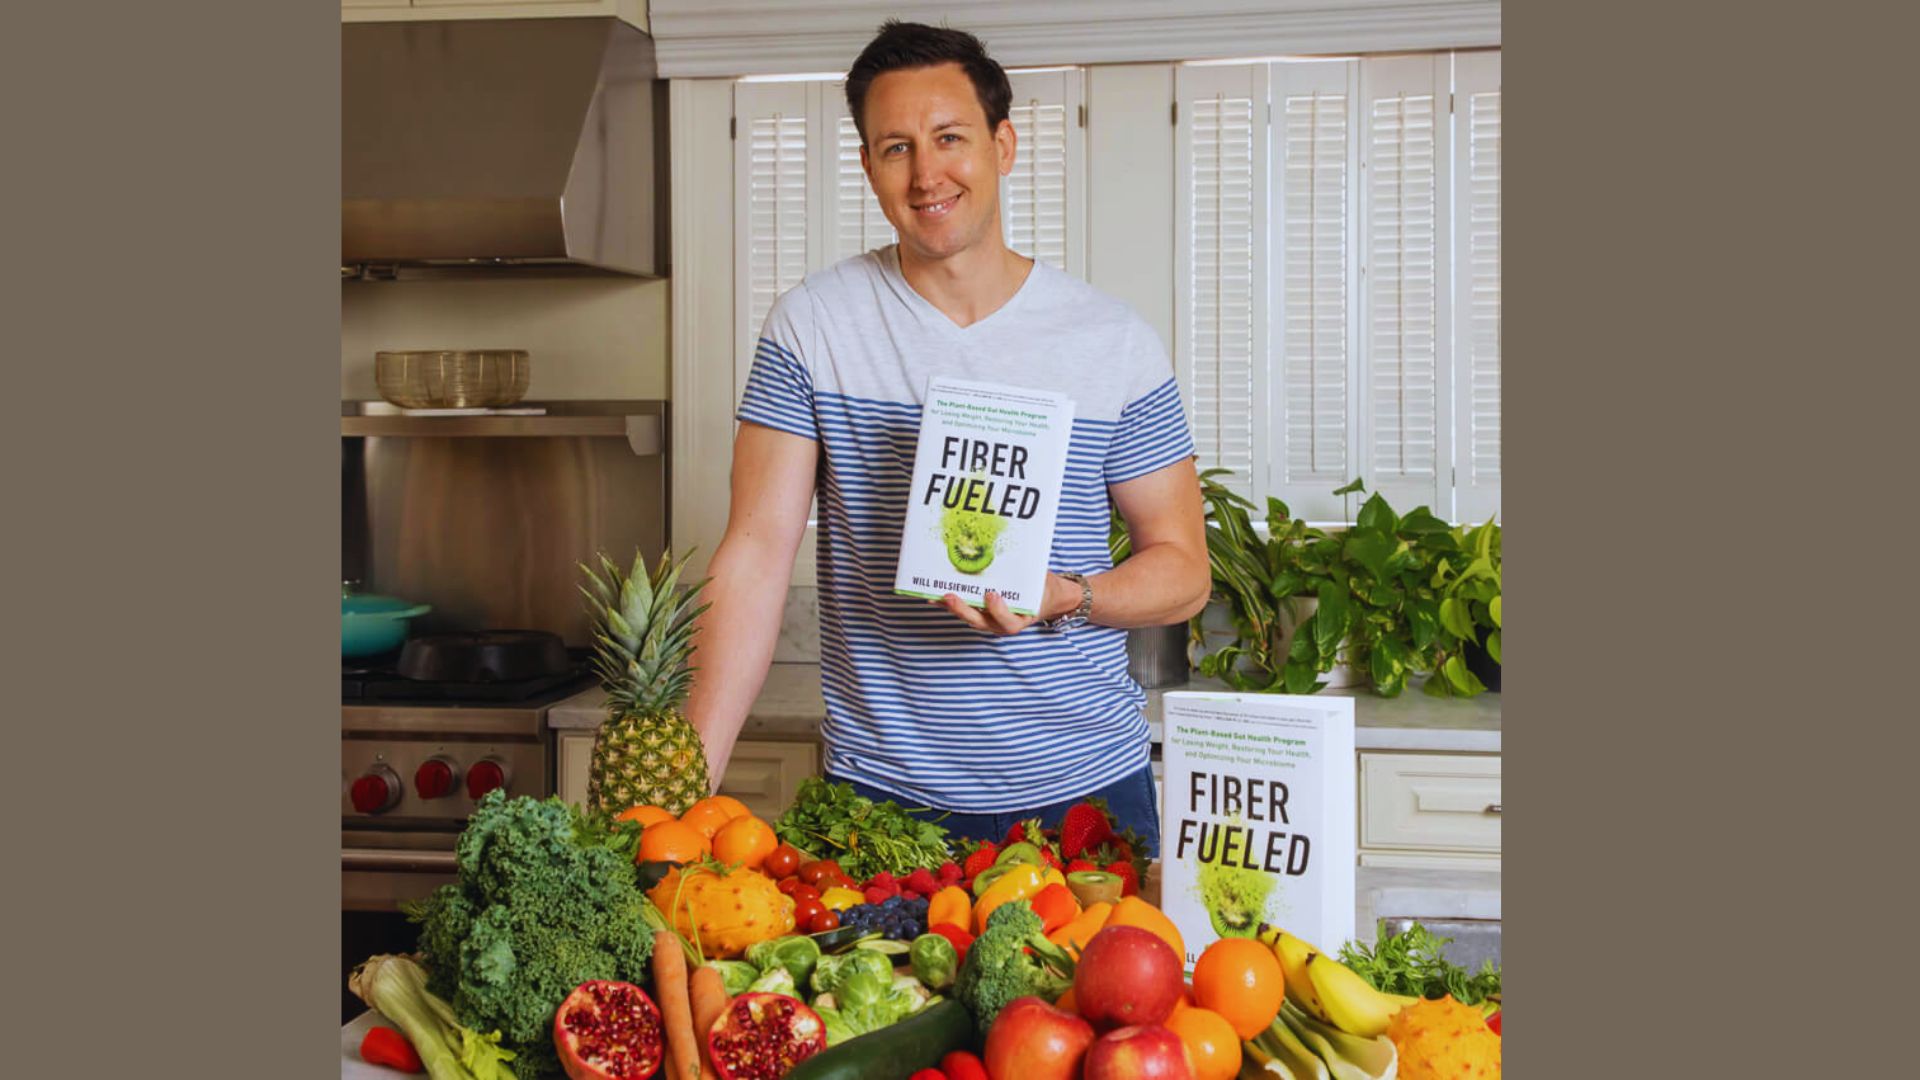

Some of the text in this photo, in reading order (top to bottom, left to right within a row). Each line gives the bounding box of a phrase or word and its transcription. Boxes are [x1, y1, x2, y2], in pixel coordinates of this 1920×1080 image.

[936, 399, 1048, 420] The Plant-Based Gut Health Program
[941, 436, 1028, 479] FIBER
[924, 473, 1041, 520] FUELED
[912, 576, 930, 587] WILL
[933, 579, 982, 595] BULSIEWICZ,
[1001, 590, 1020, 601] MSCI
[1176, 725, 1306, 746] The Plant-Based Gut Health Program
[1182, 738, 1204, 748] Losing
[1231, 743, 1266, 755] Restoring
[1267, 747, 1284, 755] Your
[1285, 749, 1312, 759] Health,
[1198, 751, 1235, 764] Optimizing
[1236, 755, 1252, 763] Your
[1253, 757, 1296, 768] Microbiome
[1190, 771, 1290, 824] FIBER
[1176, 818, 1311, 876] FUELED
